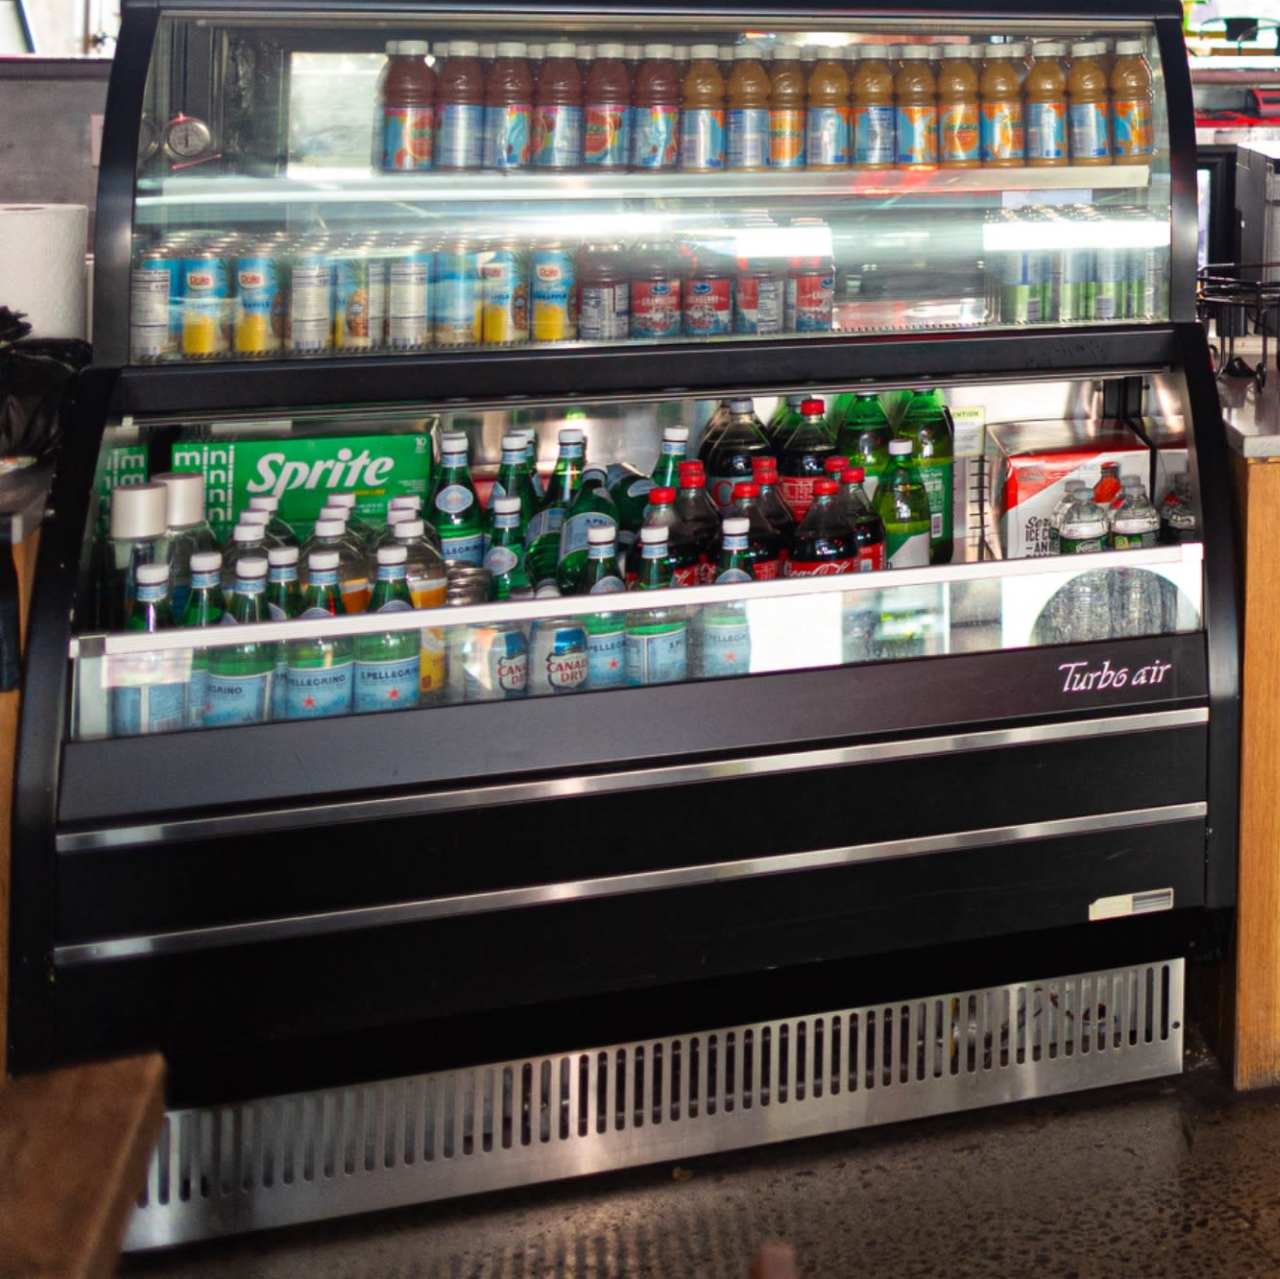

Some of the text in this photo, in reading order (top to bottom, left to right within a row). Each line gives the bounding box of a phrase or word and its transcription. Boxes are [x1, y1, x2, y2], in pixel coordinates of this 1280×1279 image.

[174, 443, 236, 467] mini
[246, 447, 396, 500] Sprite
[1058, 659, 1172, 693] Turbo air
